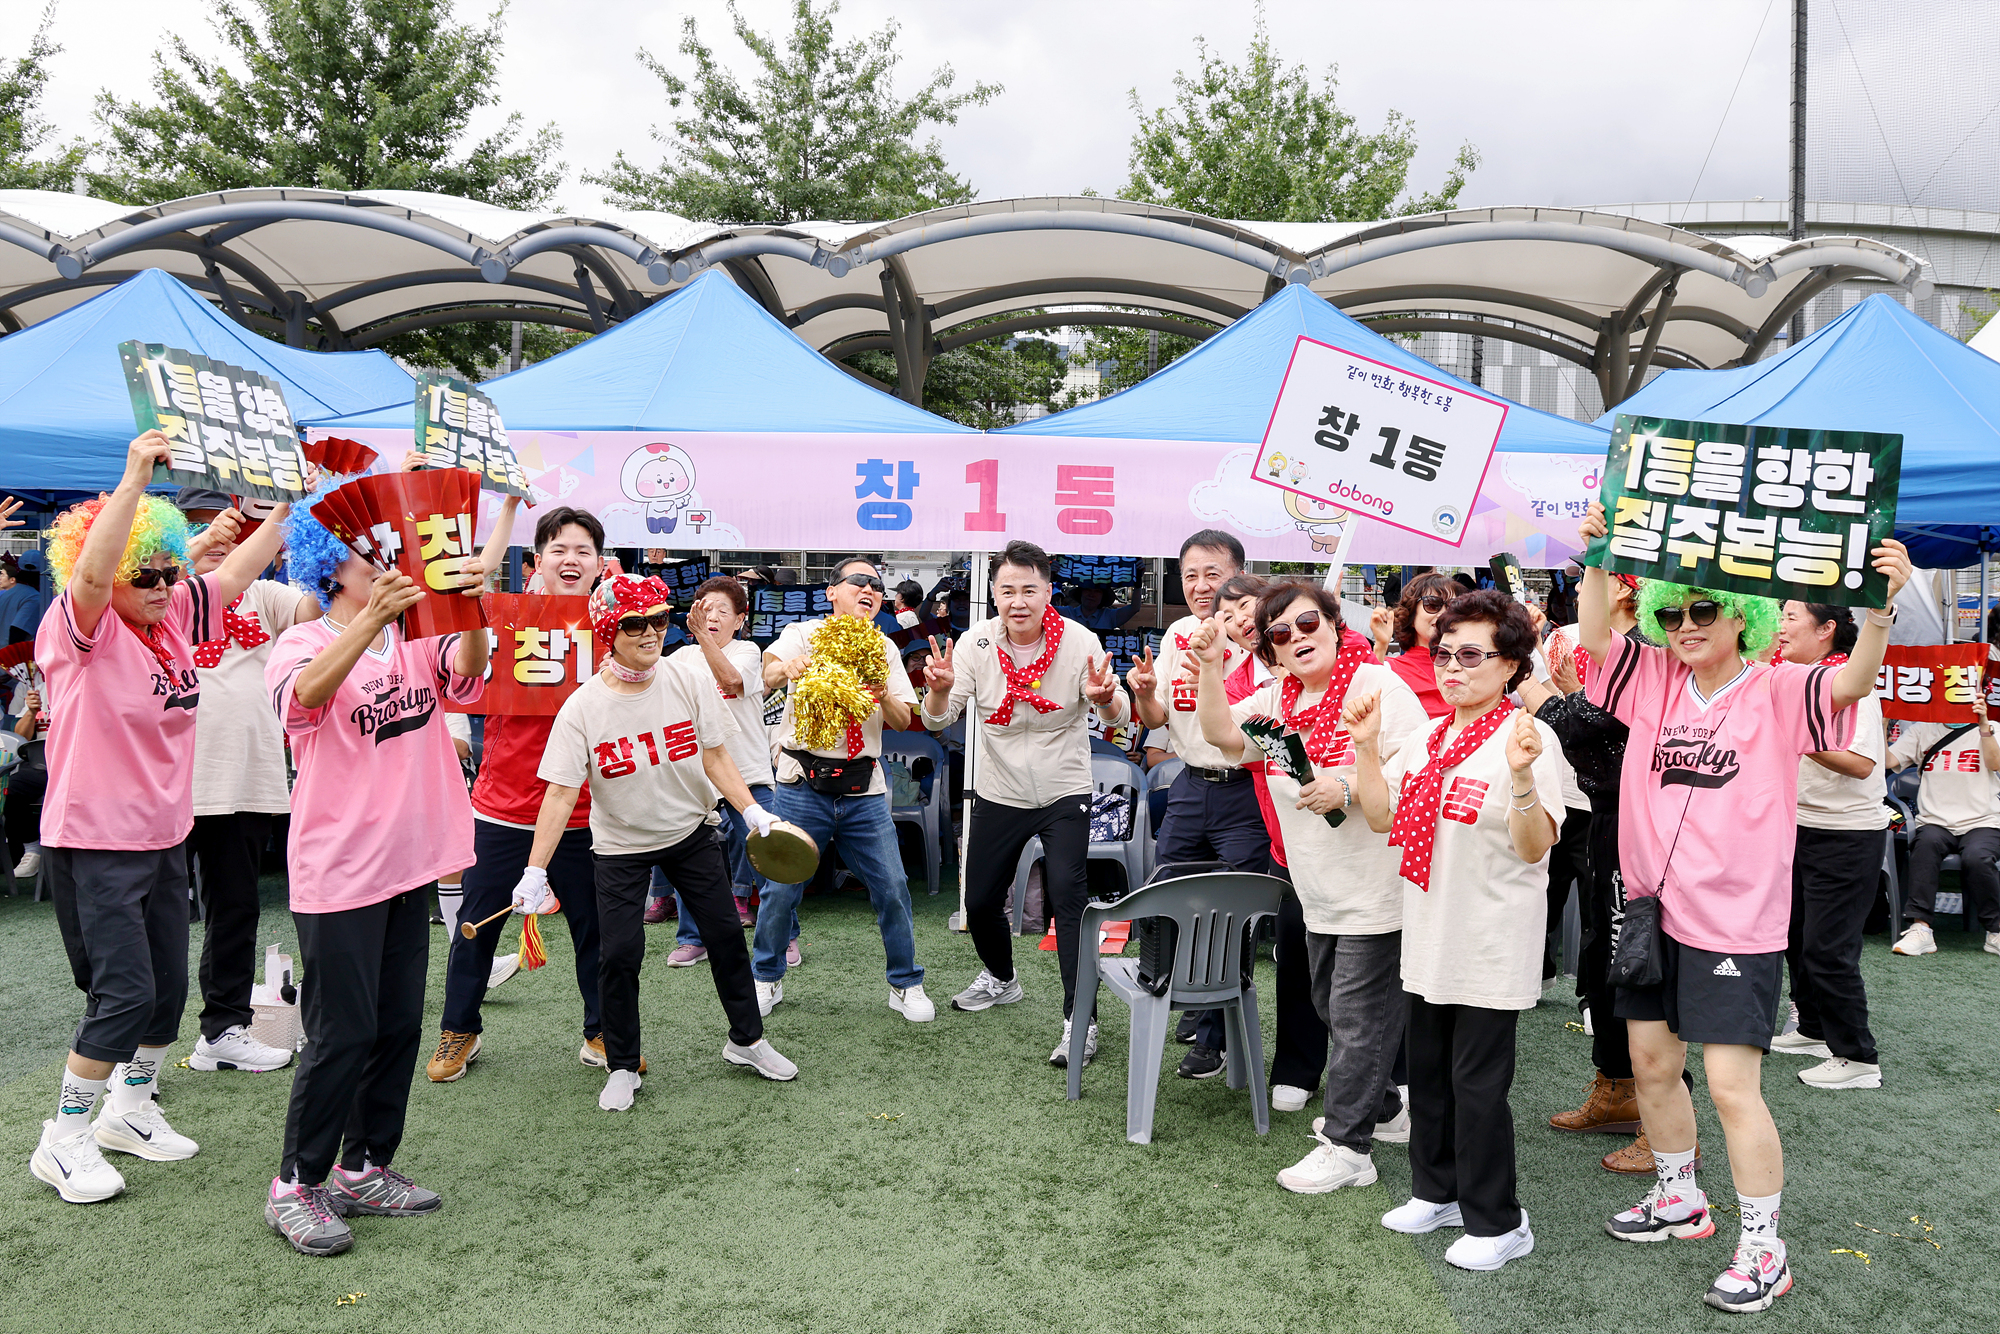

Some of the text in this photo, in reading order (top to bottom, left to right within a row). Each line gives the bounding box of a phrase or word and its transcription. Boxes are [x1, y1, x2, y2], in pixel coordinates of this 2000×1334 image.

[1346, 364, 1453, 413] 같이 변화, 행복한 도봉
[1313, 405, 1447, 482] 창 1동
[1623, 433, 1875, 514] 1등을 향한
[854, 458, 1115, 536] 창 1 동
[1328, 479, 1394, 516] dobong
[1531, 500, 1559, 518] 같이
[1608, 495, 1869, 590] 질주본능!
[754, 590, 807, 612] 1등을
[361, 677, 384, 695] NEW
[1662, 724, 1689, 737] NEW
